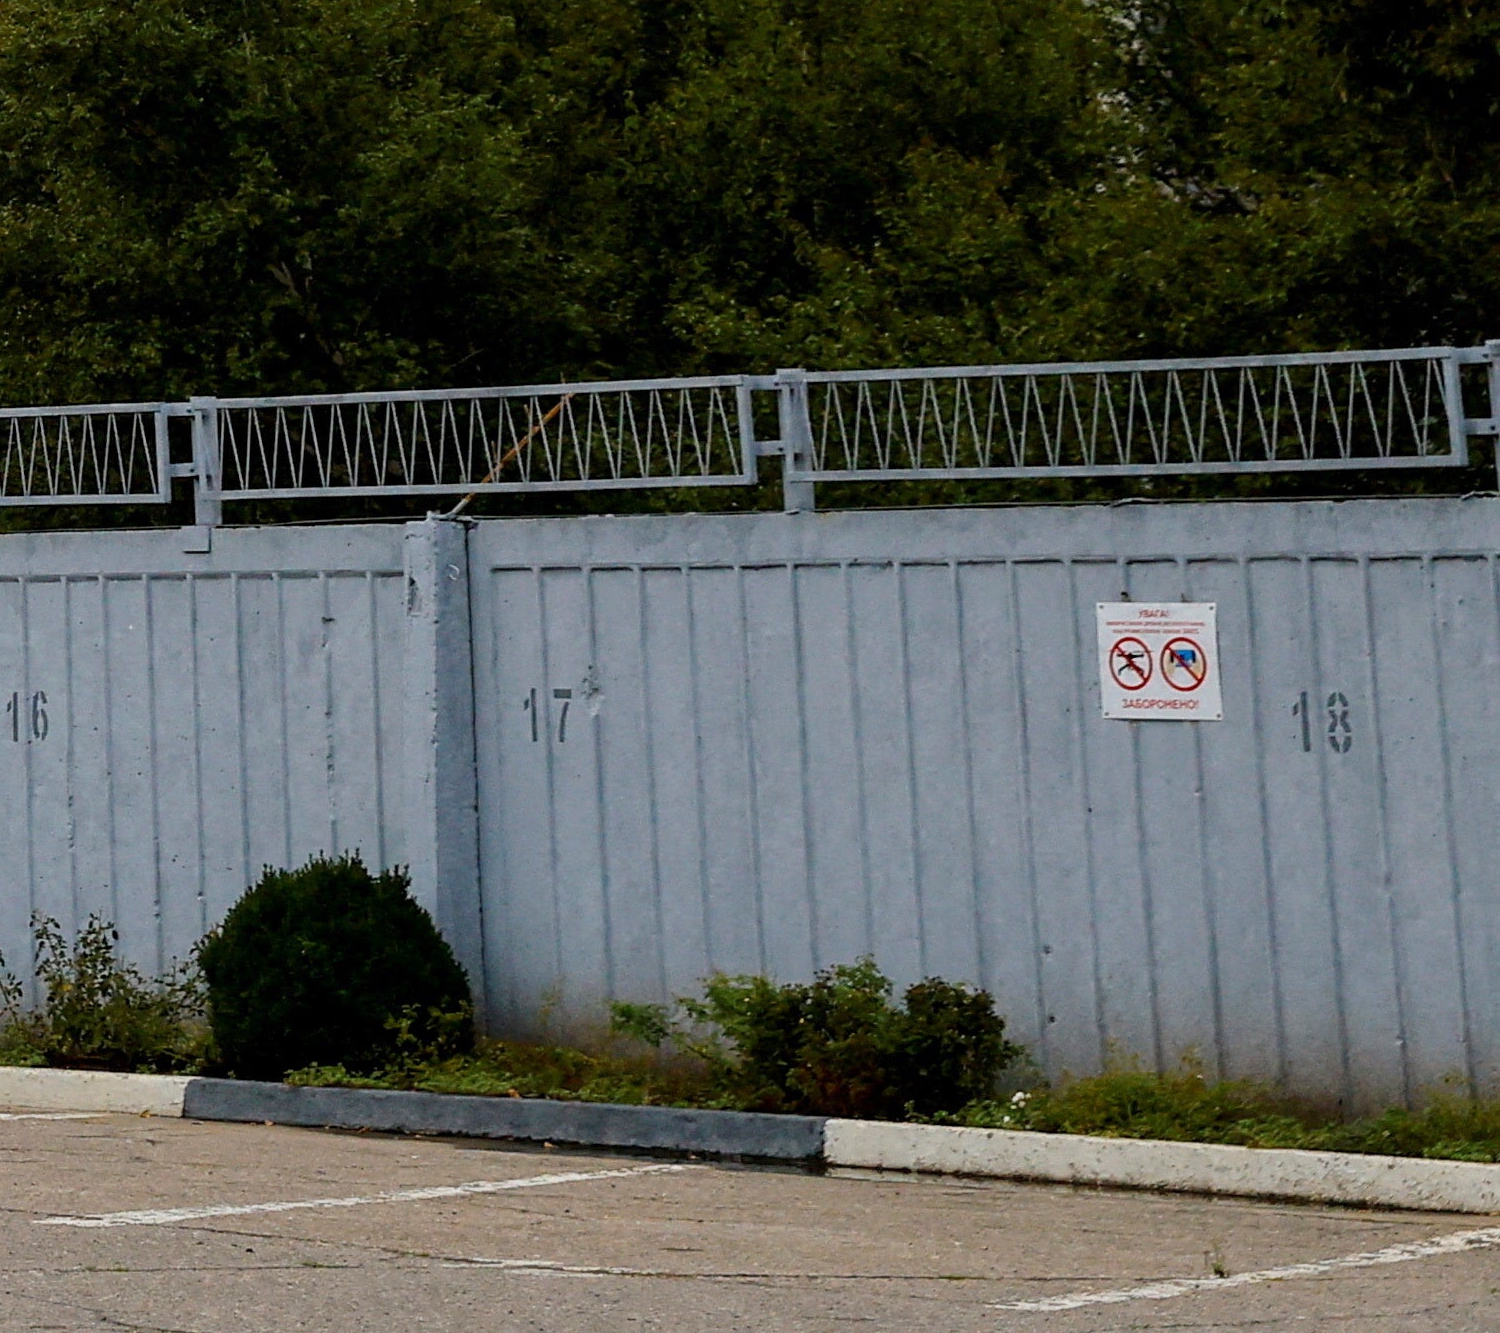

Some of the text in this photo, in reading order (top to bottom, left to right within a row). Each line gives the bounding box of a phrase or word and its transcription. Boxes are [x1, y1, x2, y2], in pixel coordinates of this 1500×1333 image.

[6, 690, 49, 742] 16
[523, 687, 572, 743] 17
[1121, 698, 1200, 710] ЗАБОРОНЕНО!
[1291, 691, 1352, 754] 18
